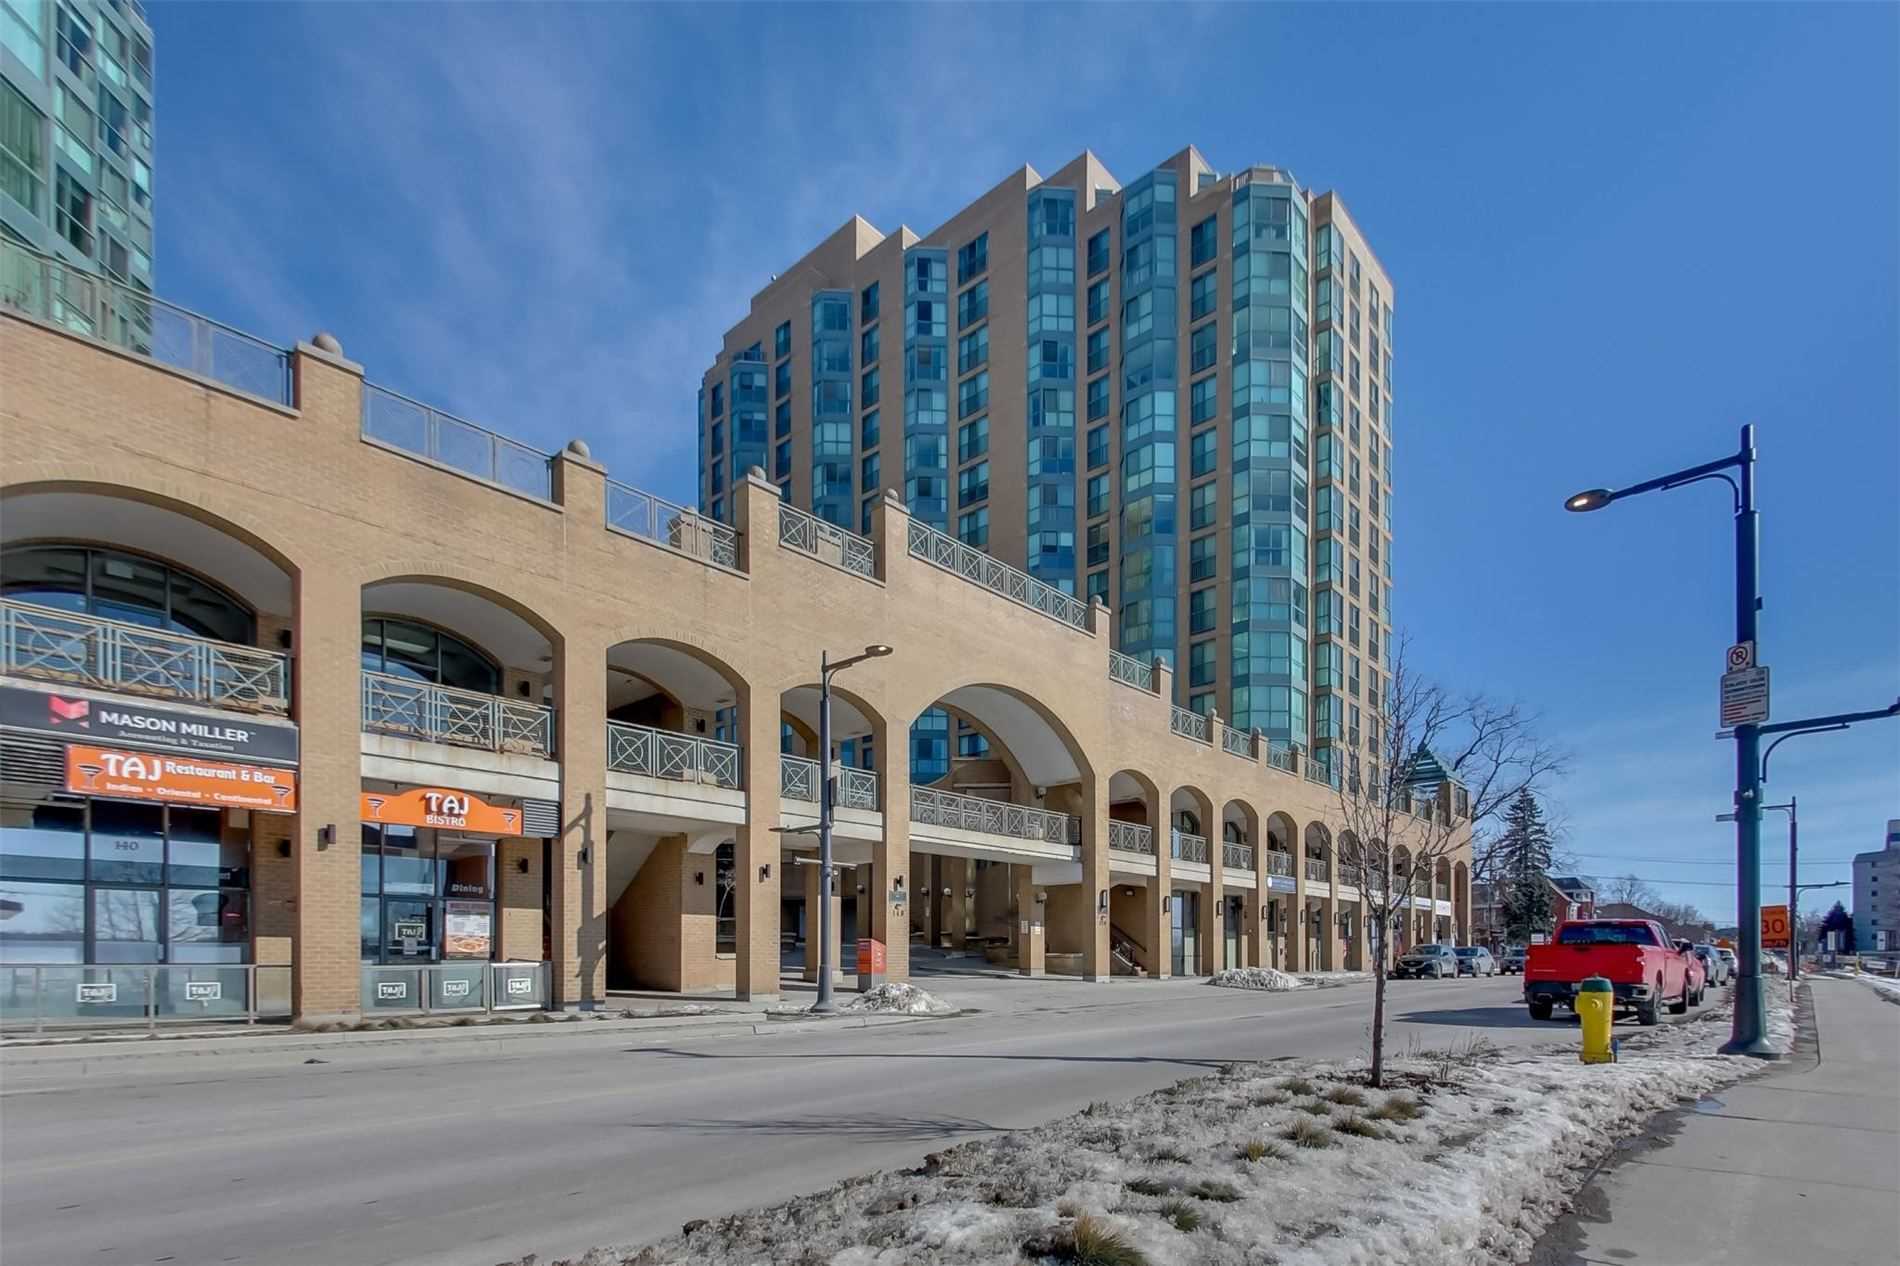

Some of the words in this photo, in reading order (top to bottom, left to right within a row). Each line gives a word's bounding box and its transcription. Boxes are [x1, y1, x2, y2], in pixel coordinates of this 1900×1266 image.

[99, 711, 176, 733] MASON
[180, 722, 249, 743] MILLER
[100, 753, 161, 781] TAJ
[165, 761, 236, 780] Restaurant
[240, 769, 250, 781] &
[253, 771, 276, 784] Bar
[106, 782, 143, 793] Indian
[157, 786, 202, 799] Oriental
[424, 792, 469, 815] TAJ
[451, 883, 484, 895] Dining
